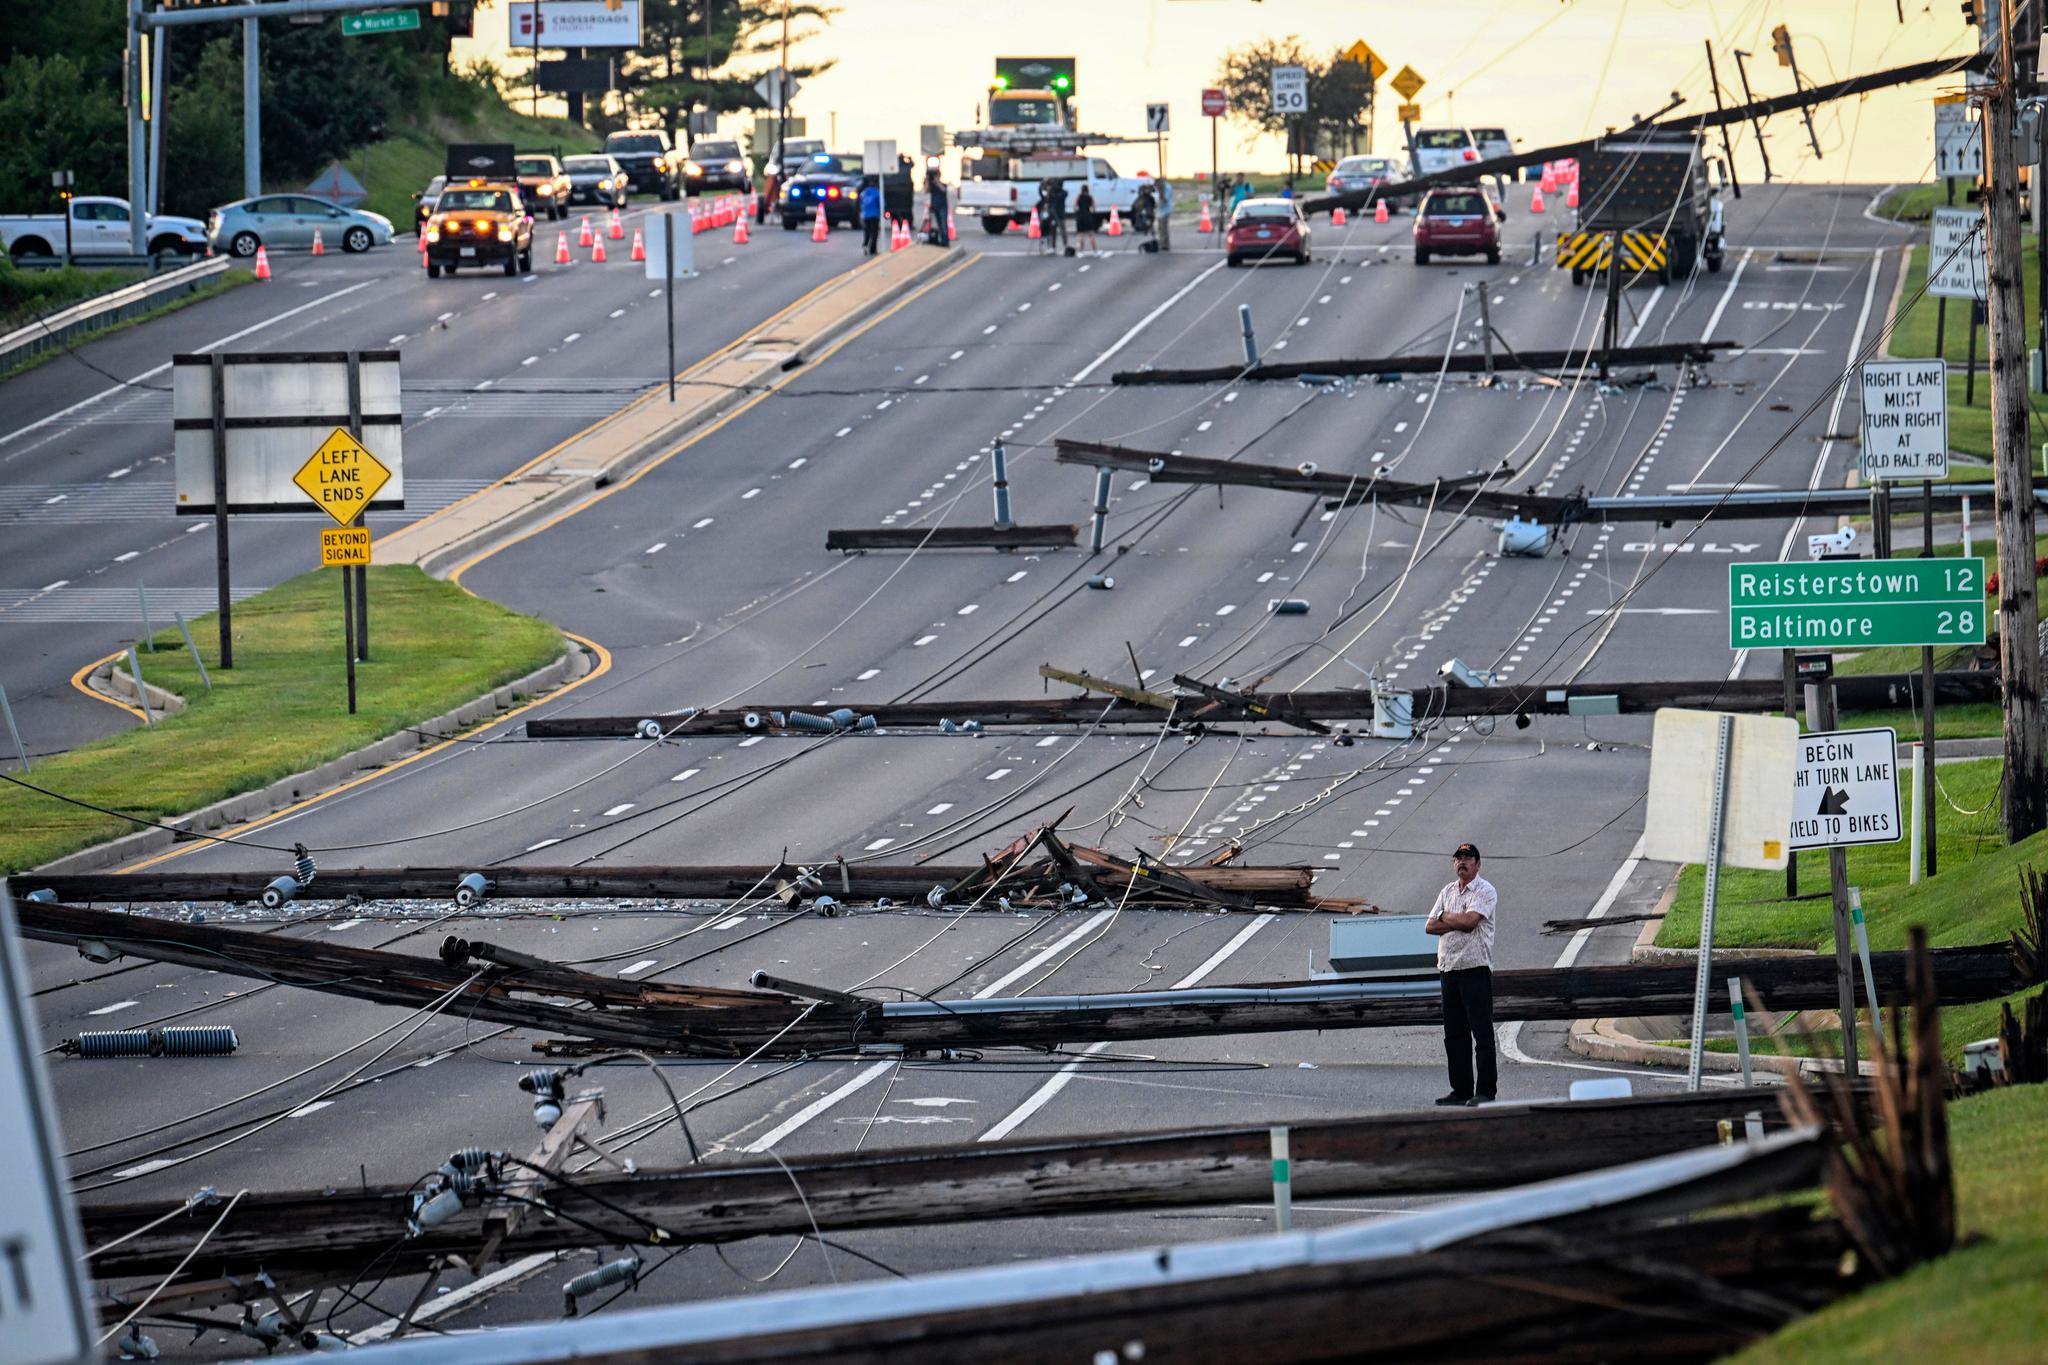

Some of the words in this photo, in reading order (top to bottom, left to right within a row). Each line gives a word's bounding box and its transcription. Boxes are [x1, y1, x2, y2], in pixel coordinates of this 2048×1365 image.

[552, 14, 629, 24] CROSSROADS
[1277, 71, 1302, 80] SPEED
[1277, 81, 1301, 90] LIMIT
[1277, 91, 1303, 108] 50
[1936, 214, 1963, 228] RIGHT
[1955, 263, 1966, 273] AT
[1742, 301, 1846, 312] ONLY
[1865, 372, 1902, 388] RIGHT
[1907, 371, 1942, 387] LANE
[1884, 391, 1922, 409] MUST
[1866, 413, 1900, 429] TURN
[1905, 411, 1942, 428] RIGHT
[1897, 433, 1912, 448] AT
[321, 449, 360, 465] LEFT
[1867, 454, 1890, 469] OLD
[320, 468, 361, 484] LANE
[323, 487, 364, 503] ENDS
[324, 532, 367, 546] BEYOND
[326, 548, 366, 561] SIGNAL
[1622, 542, 1762, 553] ONLY
[1740, 570, 1919, 598] Reisterstown
[1944, 567, 1974, 592] 12
[1740, 614, 1873, 640] Baltimore
[1936, 610, 1974, 635] 28
[1806, 743, 1854, 763] BEGIN
[1816, 766, 1849, 786] TURN
[1856, 763, 1890, 783] LANE
[1825, 817, 1841, 835] TO
[1849, 813, 1890, 834] BIKES
